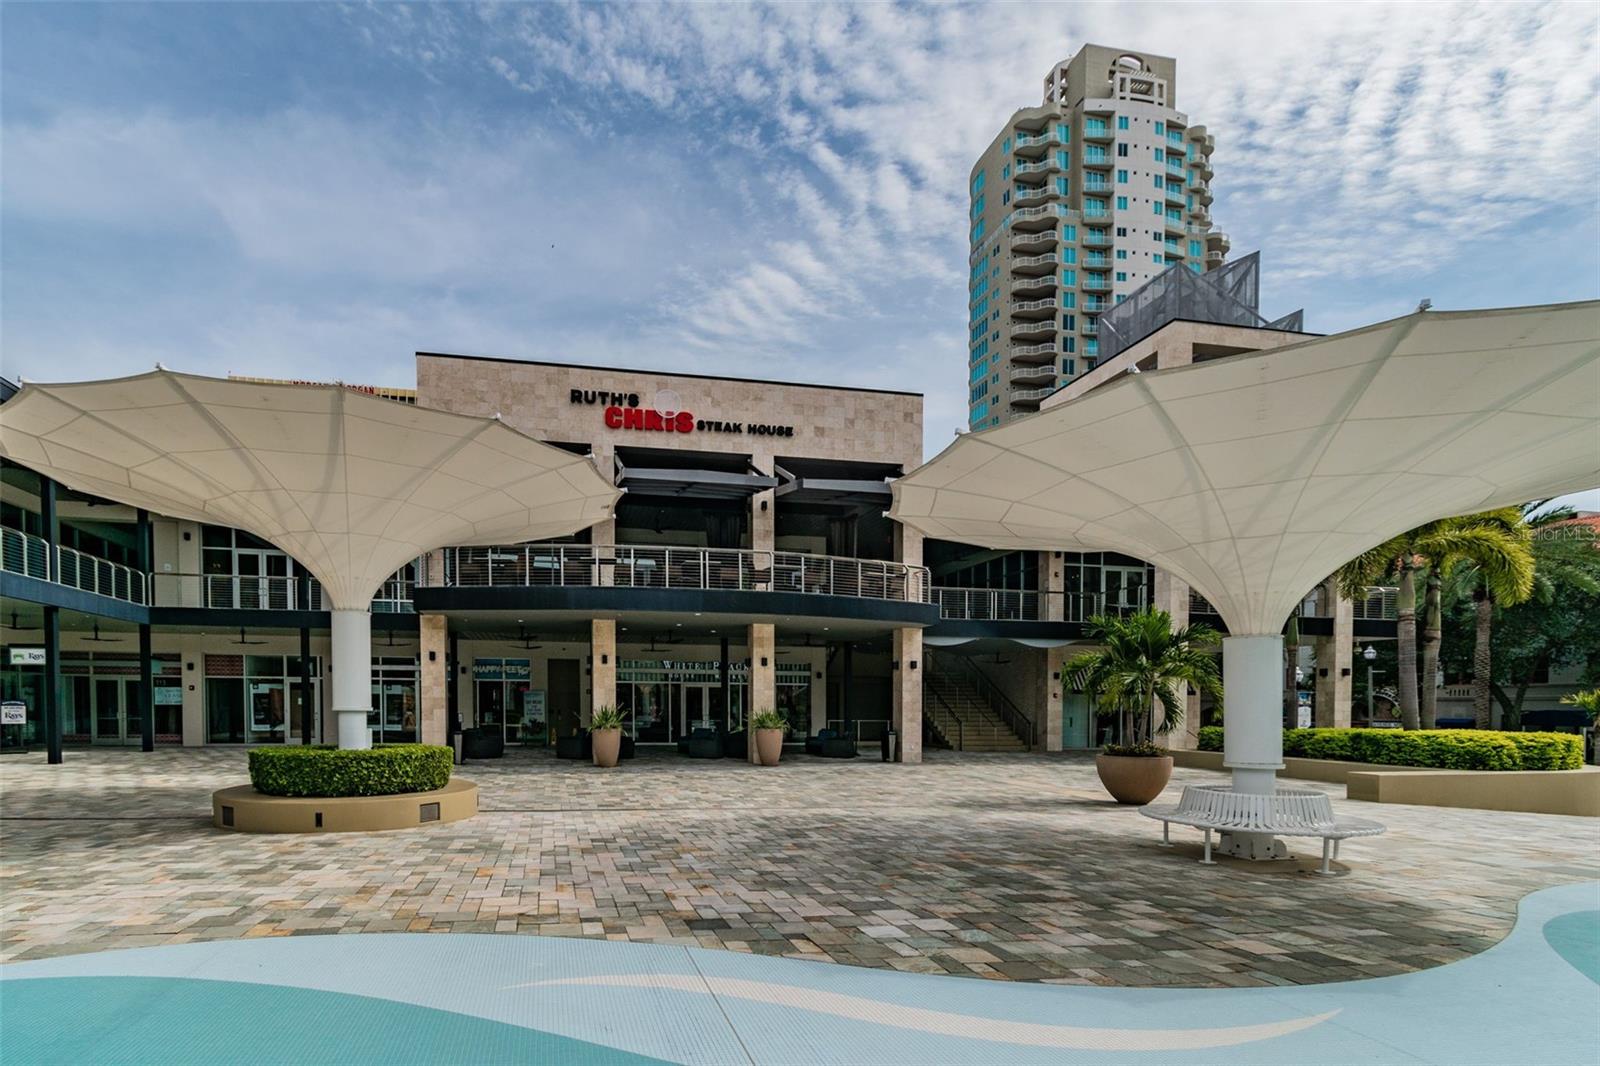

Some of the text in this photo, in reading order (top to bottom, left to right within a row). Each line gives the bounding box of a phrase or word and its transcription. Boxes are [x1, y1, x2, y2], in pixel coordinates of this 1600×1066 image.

[570, 389, 640, 407] RUTH'S
[605, 407, 694, 433] CHRIS
[696, 420, 794, 437] STEAK HOUSE
[663, 660, 701, 670] WHITE
